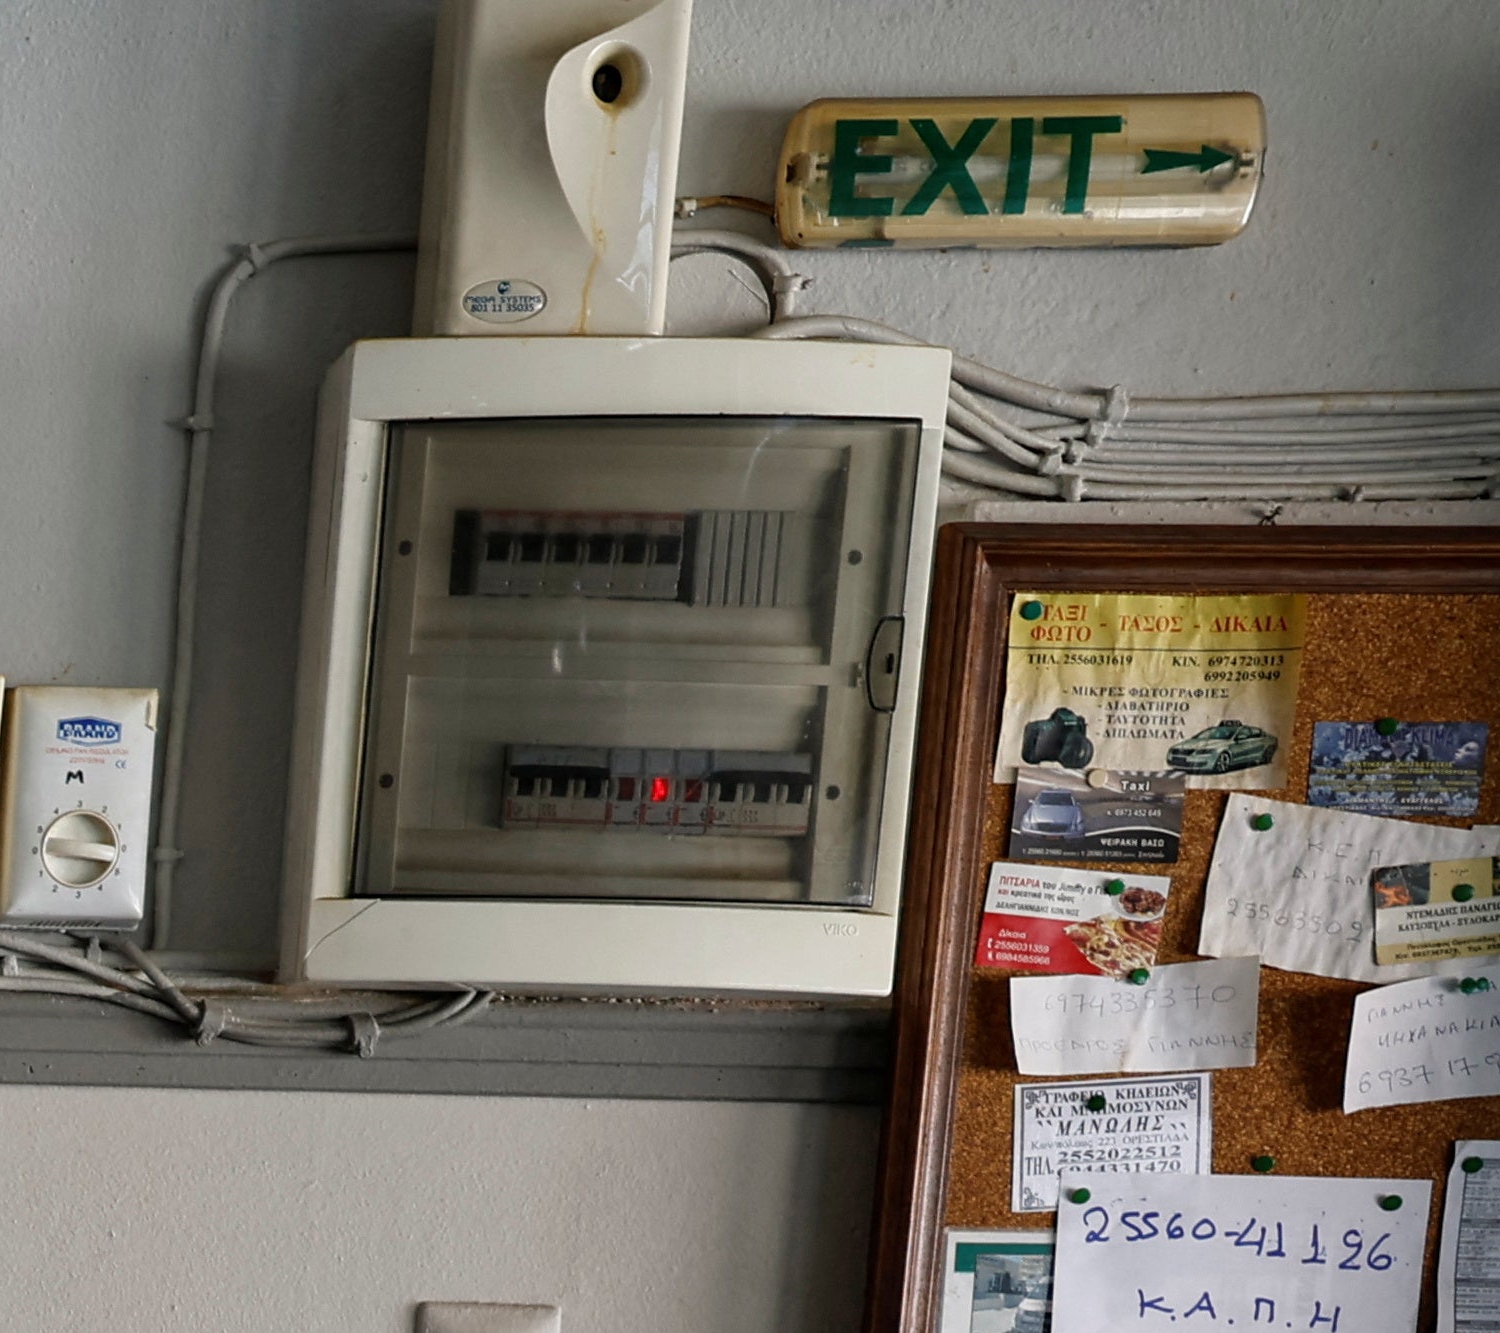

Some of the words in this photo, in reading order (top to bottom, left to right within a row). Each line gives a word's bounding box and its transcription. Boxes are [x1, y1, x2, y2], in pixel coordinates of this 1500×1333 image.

[829, 116, 1122, 217] EXIT
[1041, 605, 1088, 622] ΤΑΞΙ
[1210, 615, 1288, 633] ΔΙΚΑΙΑ
[1031, 625, 1092, 642] ΦΩΤΟ
[1027, 654, 1059, 665] ΤΗΛ.
[1063, 655, 1133, 666] 2556031619
[1172, 656, 1200, 667] ΚΙΝ.
[1208, 655, 1284, 667] 6974720313
[1204, 670, 1281, 682] 6992205949
[1071, 686, 1125, 698] ΜΙΚΡΕΣ
[1128, 687, 1229, 699] ΦΩΤΟΓΡΑΦΙΕΣ
[1104, 701, 1190, 712] ΔΙΑΒΑΤΗΡΙΟ
[1107, 715, 1186, 726] ΤΑΥΤΟΤΗΤΑ
[64, 724, 116, 738] BRAND
[1102, 728, 1184, 740] ΔΙΠΛΩΜΑΤΑ
[65, 769, 84, 784] M
[1121, 781, 1150, 791] Taxi
[999, 875, 1040, 888] ΠΙΤΣΑΡΙΑ
[1292, 866, 1368, 886] ΔΙΚΑΙ
[1407, 907, 1458, 919] ΝΤΕΜΑΔΗΣ
[823, 923, 857, 936] VIKO
[1116, 1085, 1181, 1100] ΚΗΔΕΙΩΝ
[1035, 1106, 1062, 1118] ΚΑΙ
[1123, 1133, 1189, 1144] ΟΡΕΣΤΙΑΔΑ
[1058, 1145, 1181, 1163] 2552022512
